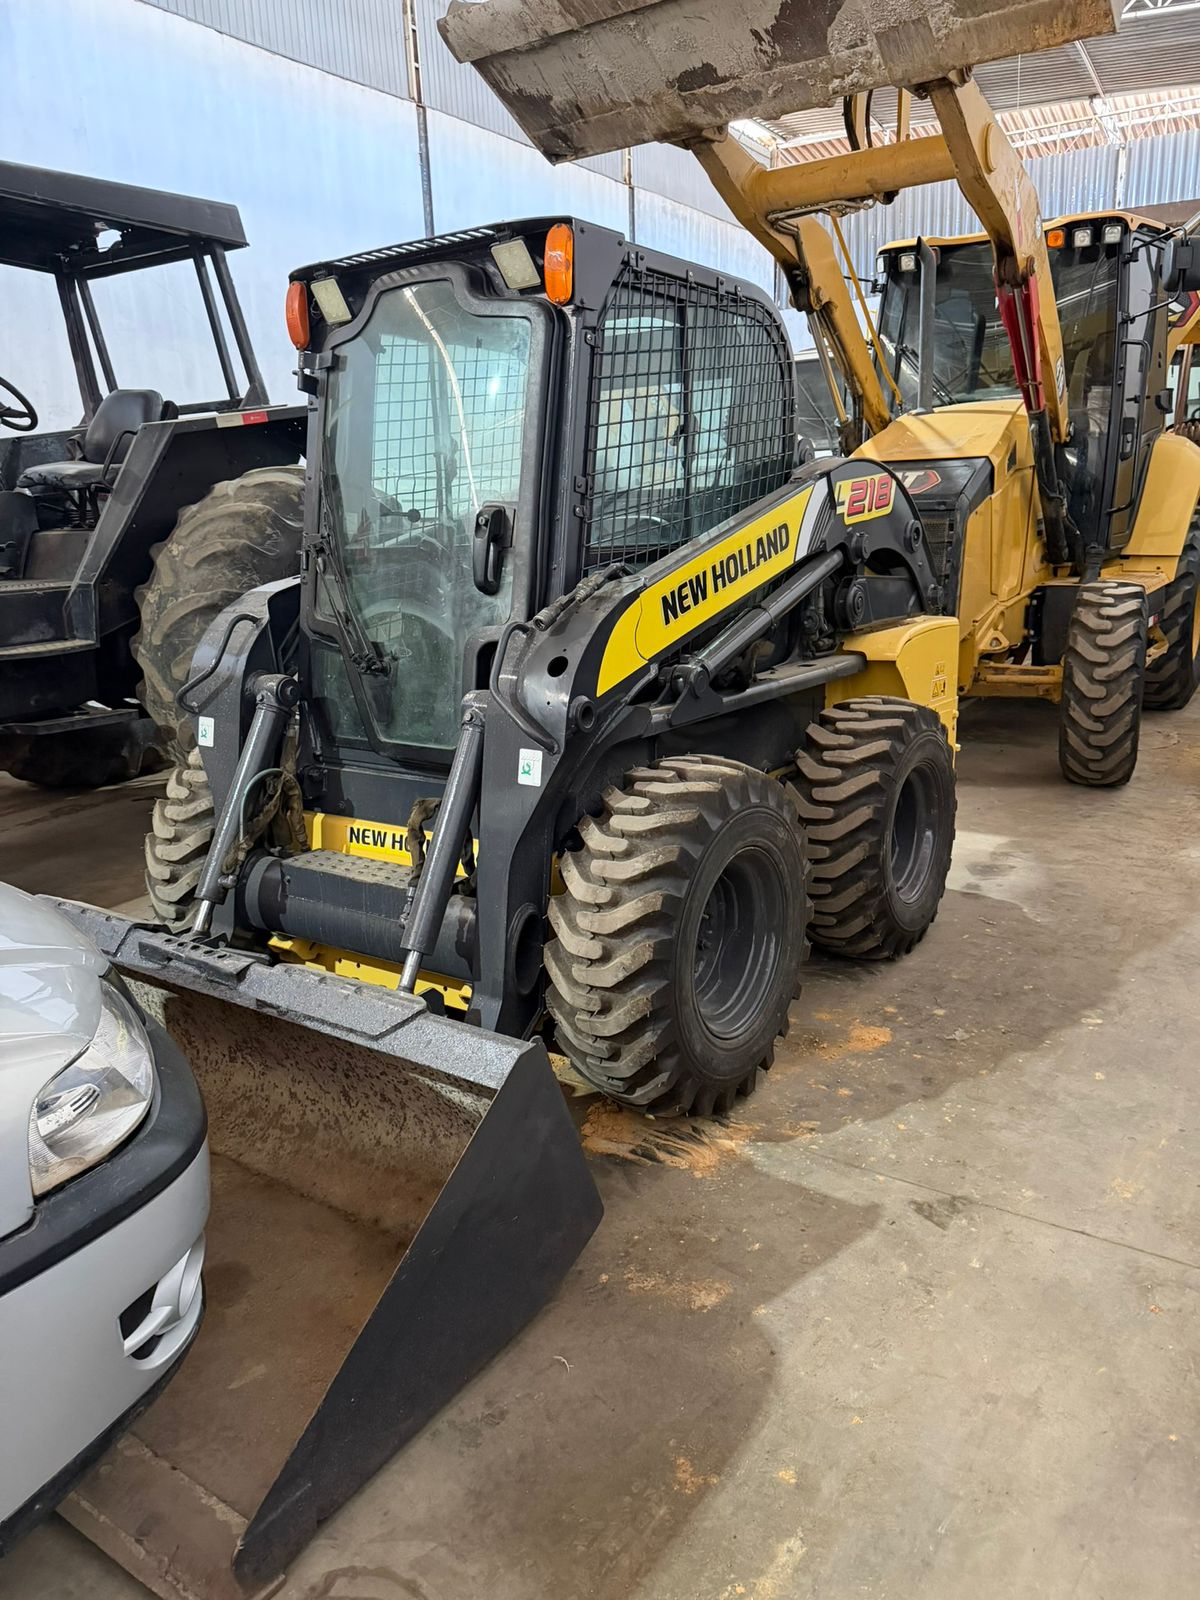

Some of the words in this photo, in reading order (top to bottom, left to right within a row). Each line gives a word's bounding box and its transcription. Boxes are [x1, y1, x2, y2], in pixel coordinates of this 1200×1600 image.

[661, 570, 708, 626] NEW
[711, 522, 790, 594] HOLLAND
[349, 826, 388, 848] NEW
